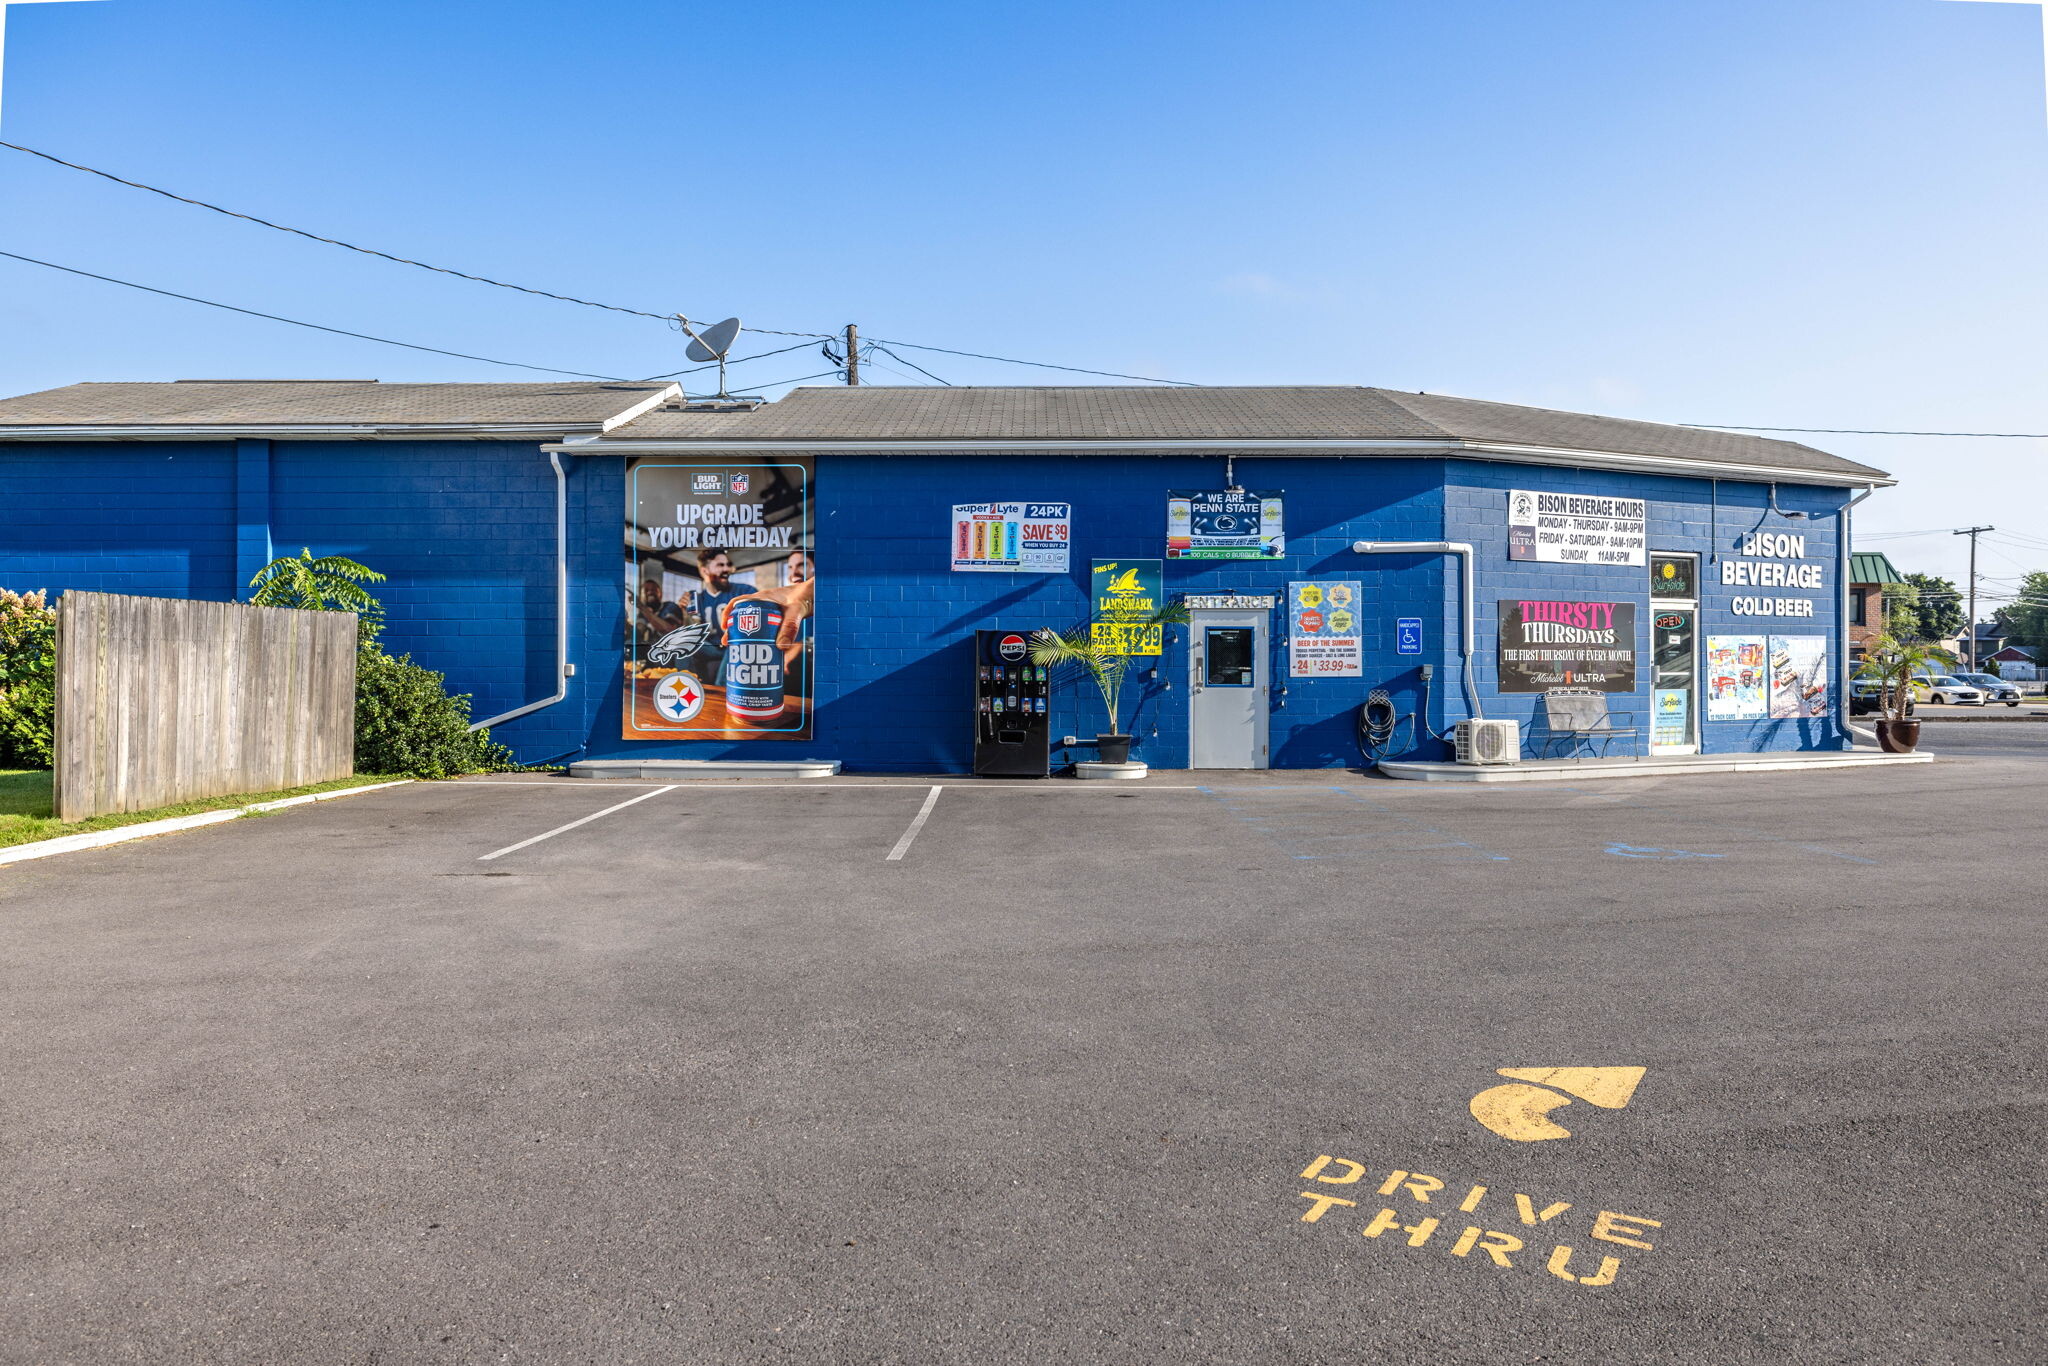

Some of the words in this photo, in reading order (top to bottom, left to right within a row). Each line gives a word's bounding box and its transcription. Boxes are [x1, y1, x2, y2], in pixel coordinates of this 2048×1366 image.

[732, 482, 746, 491] NFL
[1208, 494, 1223, 502] WE
[1225, 494, 1244, 502] ARE
[1538, 494, 1567, 513] BISON
[1569, 498, 1612, 516] BEVERAGE
[1615, 501, 1643, 518] HOURS
[676, 504, 764, 525] UPGRADE
[998, 504, 1018, 514] Lyte
[1030, 506, 1064, 517] 24PK
[1193, 504, 1222, 512] PENN
[1226, 504, 1259, 512] STATE
[1023, 524, 1053, 540] SAVE
[1055, 524, 1067, 540] $9
[1538, 516, 1568, 529] MONDAY
[1573, 519, 1609, 532] THURSDAY
[1614, 522, 1644, 533] 9AM-9PM
[648, 526, 699, 548] YOUR
[702, 526, 792, 548] GAMEDAY
[1510, 536, 1536, 545] ULTRA
[1539, 532, 1564, 544] FRIDAY
[1569, 534, 1605, 546] SATURDAY
[1610, 536, 1643, 548] 9AM-10PM
[1742, 532, 1804, 558] BISON
[1561, 549, 1588, 560] SUNDAY
[1598, 551, 1630, 562] 11AM-5PM
[1094, 566, 1107, 574] FINS
[1722, 561, 1822, 588] BEVERAGE
[1652, 576, 1685, 592] Surfside
[1100, 597, 1153, 610] LANDSHARK
[1191, 596, 1268, 608] ENTRANCE
[1732, 596, 1773, 616] COLD
[1775, 598, 1813, 617] BEER
[740, 616, 758, 630] NFL
[1518, 601, 1616, 629] THIRSTY
[1656, 616, 1681, 628] OPEN
[1521, 622, 1615, 643] THURSDAYS
[729, 644, 773, 664] BUD
[1504, 650, 1517, 660] THE
[1519, 650, 1539, 660] FIRST
[1540, 650, 1576, 660] THURSDAY
[1577, 650, 1585, 660] OF
[1586, 650, 1607, 660] EVERY
[1608, 650, 1631, 661] MONTH
[1297, 660, 1308, 670] 24
[726, 664, 779, 684] LIGHT
[1530, 672, 1564, 683] Michelob
[1573, 674, 1606, 682] ULTRA
[1300, 1154, 1662, 1250] DRIVE
[1301, 1192, 1621, 1286] THRU
